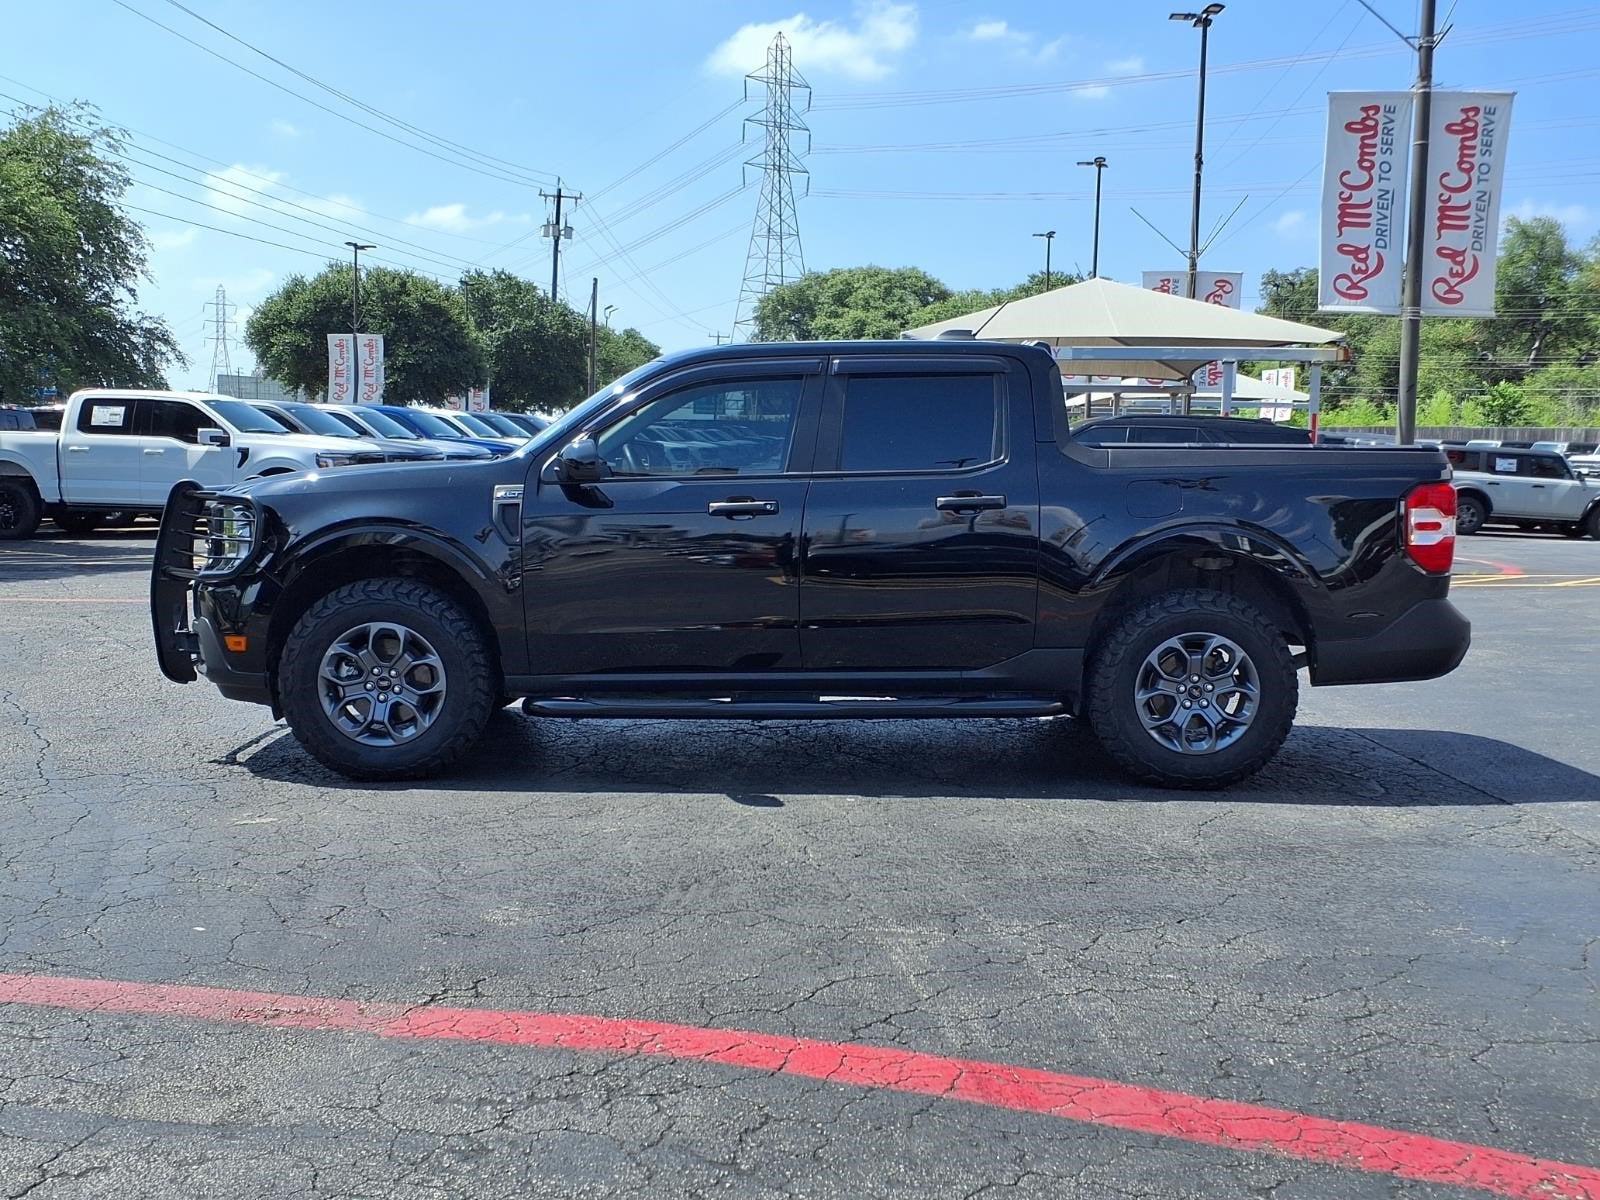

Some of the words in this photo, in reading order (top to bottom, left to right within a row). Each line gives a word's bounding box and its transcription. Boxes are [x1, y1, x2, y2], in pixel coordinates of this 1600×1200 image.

[1380, 104, 1396, 157] SERVE
[1480, 106, 1497, 157] SERVE
[1336, 104, 1382, 239] McCombs
[1378, 161, 1392, 183] TO
[1435, 105, 1481, 241] McCombs
[1477, 163, 1491, 185] TO
[1375, 189, 1390, 250] DRIVEN
[1471, 191, 1488, 252] DRIVEN
[1333, 243, 1384, 301] Red
[1431, 246, 1480, 305] Red
[332, 382, 349, 401] Red
[362, 383, 378, 401] Red
